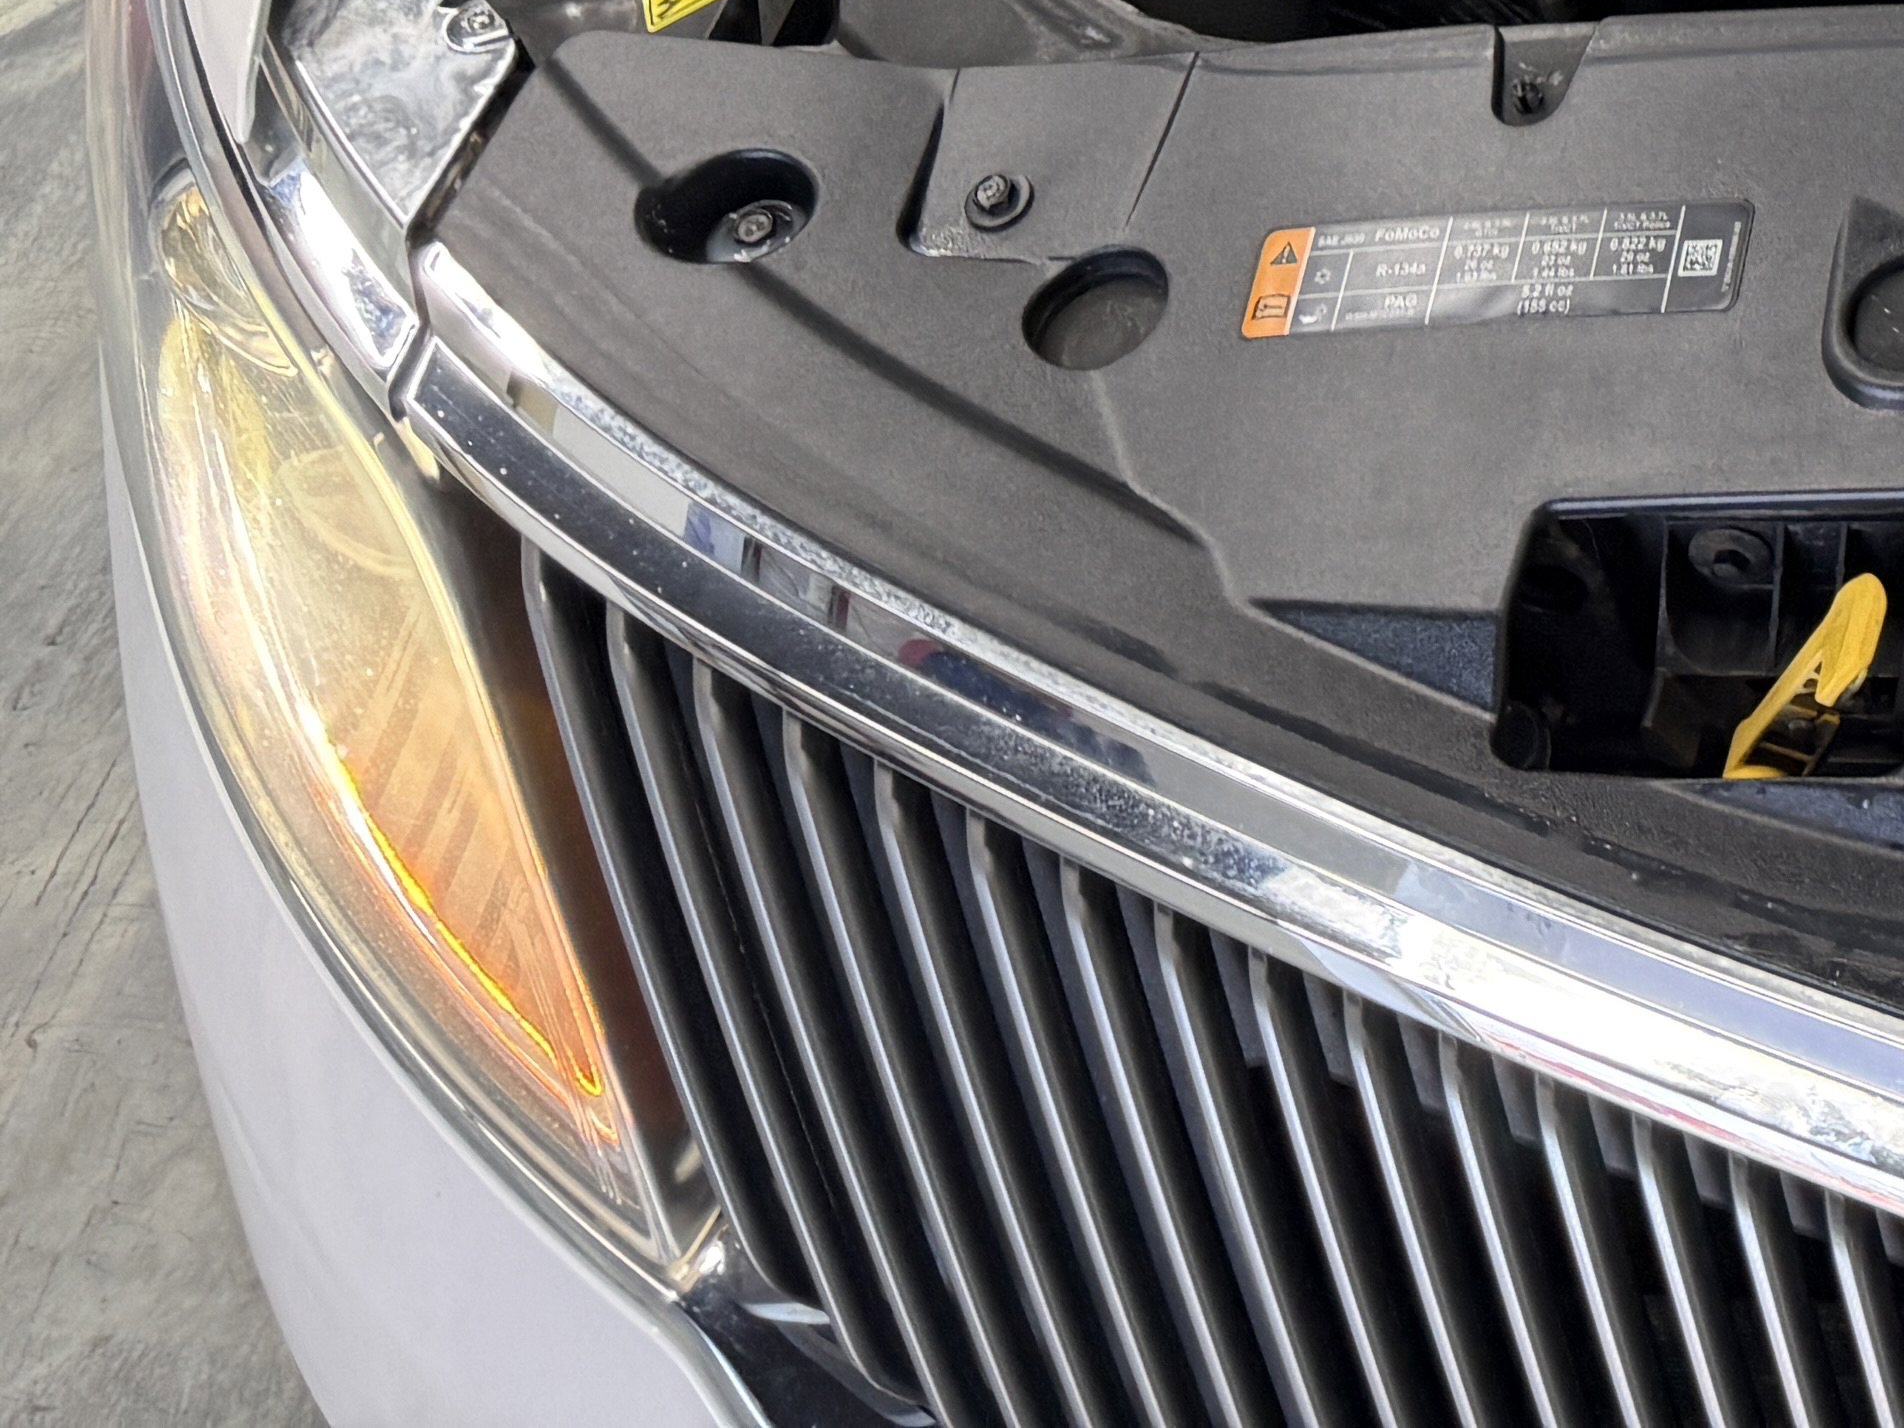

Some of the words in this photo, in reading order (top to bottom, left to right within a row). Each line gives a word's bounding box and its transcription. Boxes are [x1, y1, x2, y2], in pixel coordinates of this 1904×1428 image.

[1374, 225, 1440, 242] FoMoCo
[1492, 244, 1510, 259] kg
[1570, 240, 1588, 255] kg
[1648, 235, 1667, 253] kg
[1375, 261, 1426, 278] R-134a
[1384, 293, 1418, 310] PAG
